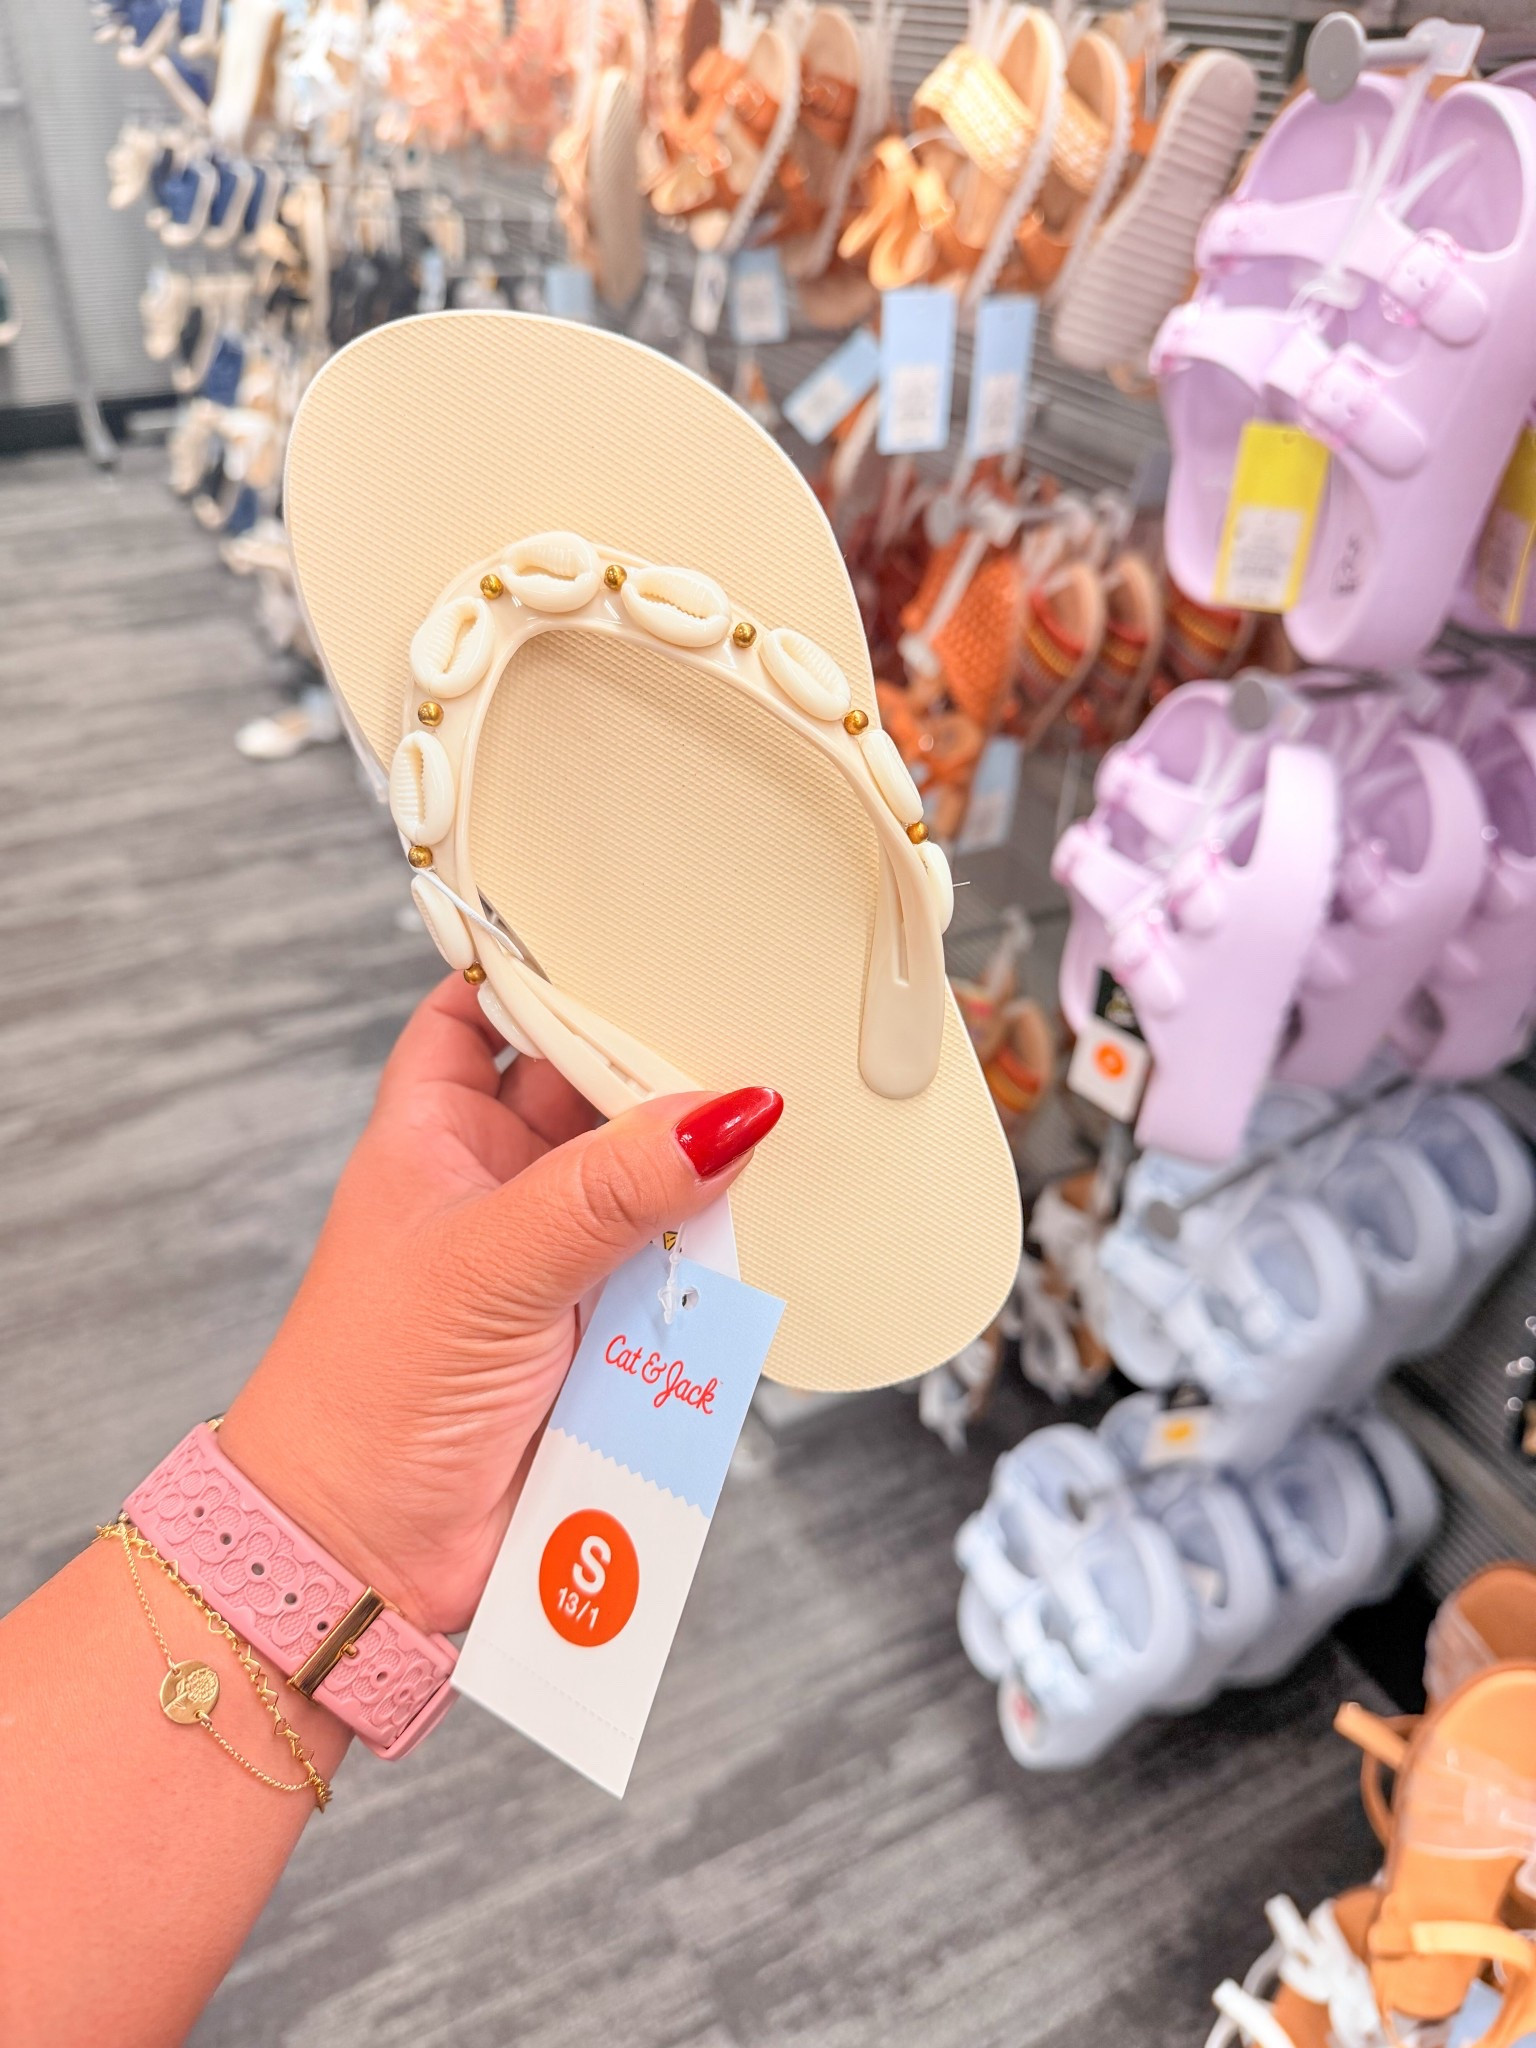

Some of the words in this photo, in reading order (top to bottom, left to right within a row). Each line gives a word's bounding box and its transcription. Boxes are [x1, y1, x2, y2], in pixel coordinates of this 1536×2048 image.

[604, 1334, 643, 1375] Cat
[641, 1351, 668, 1385] &
[653, 1360, 719, 1415] Jack
[572, 1535, 612, 1595] S
[557, 1586, 600, 1630] 13/1
